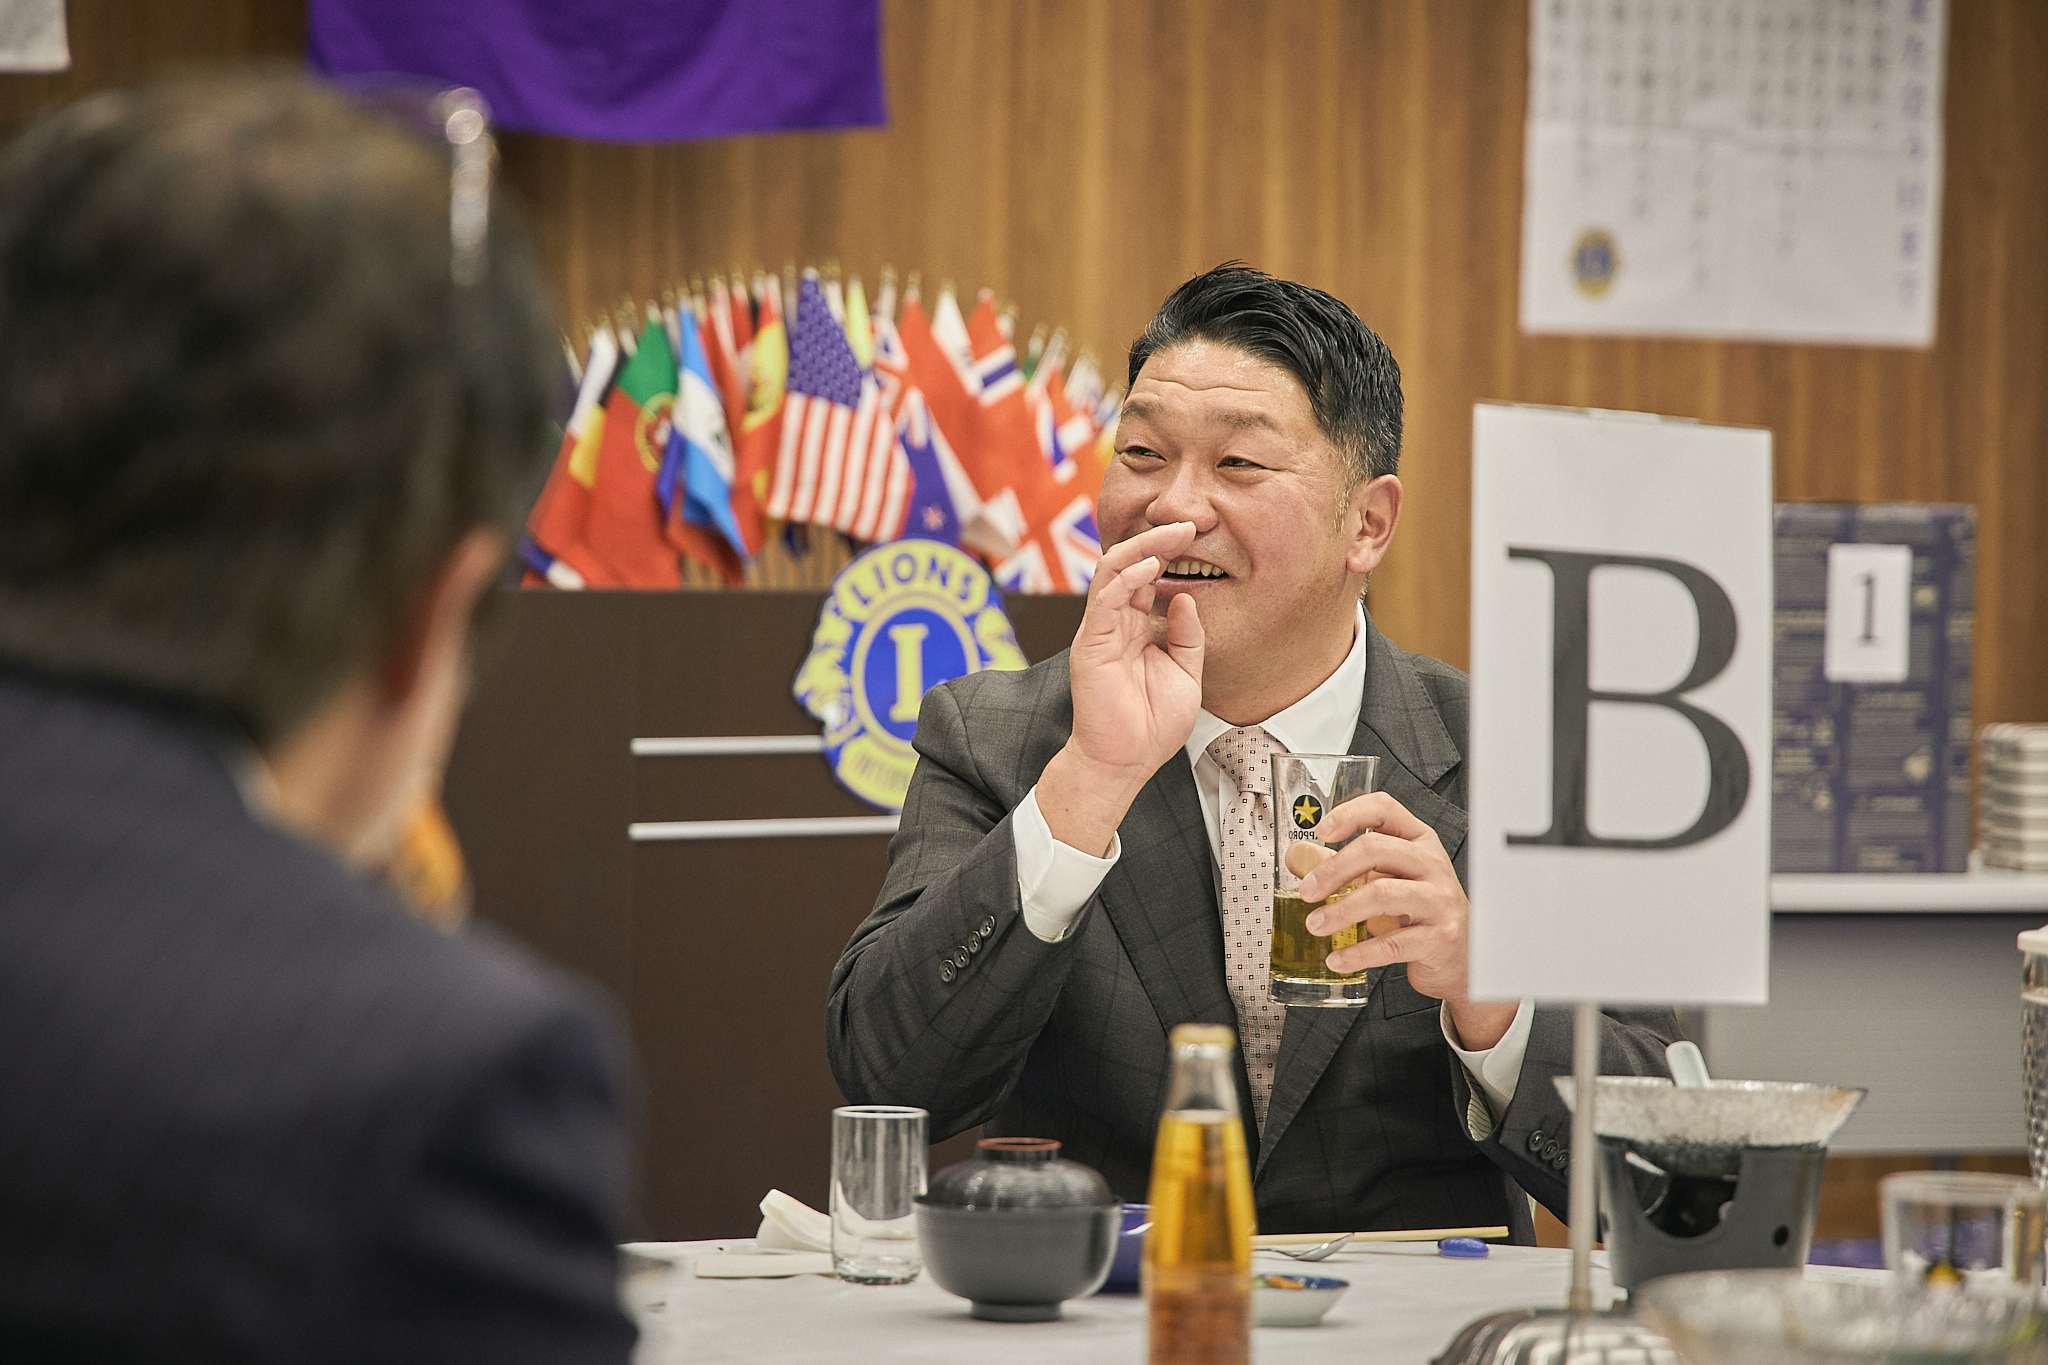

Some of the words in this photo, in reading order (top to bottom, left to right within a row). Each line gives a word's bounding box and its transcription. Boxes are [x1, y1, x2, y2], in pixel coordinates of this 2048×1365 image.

[850, 553, 974, 605] LIONS
[1854, 572, 1880, 648] 1
[1505, 545, 1751, 853] B
